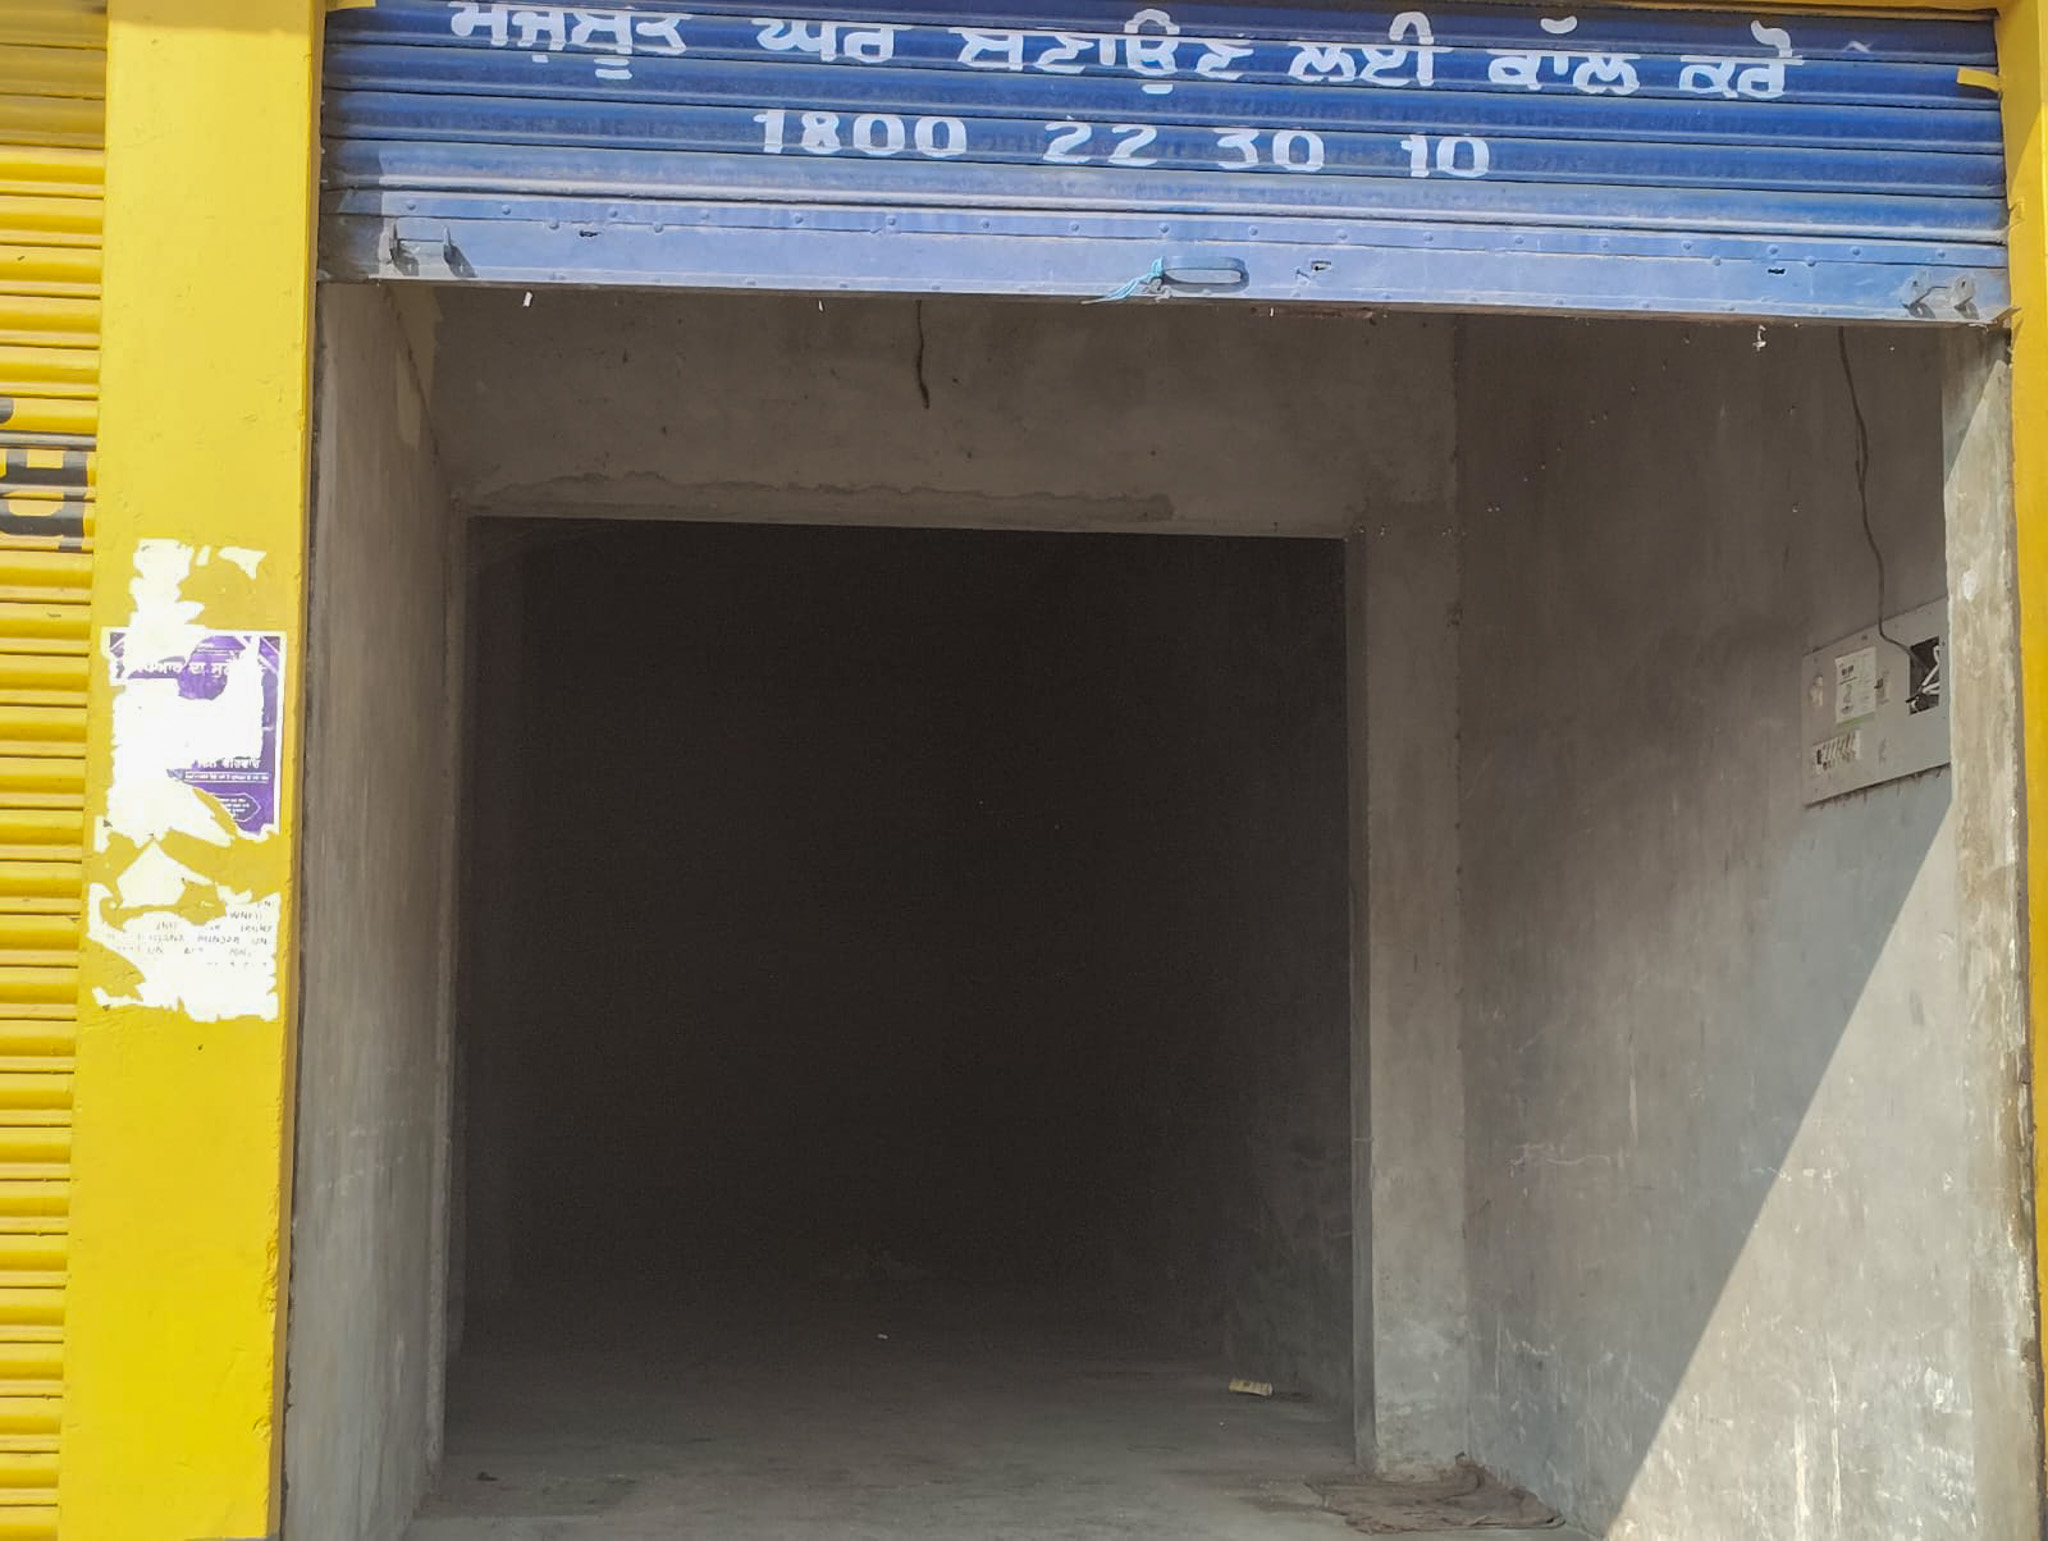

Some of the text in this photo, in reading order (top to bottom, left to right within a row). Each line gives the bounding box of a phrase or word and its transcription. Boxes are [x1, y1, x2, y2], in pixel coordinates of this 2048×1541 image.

[752, 17, 913, 63] ਘਰ
[948, 8, 1254, 95] ਬਣਾਉਣ
[1288, 11, 1455, 87] ਲਈ
[1680, 20, 1804, 99] ਕਰੋ
[753, 109, 1490, 178] 1800 22 30 10
